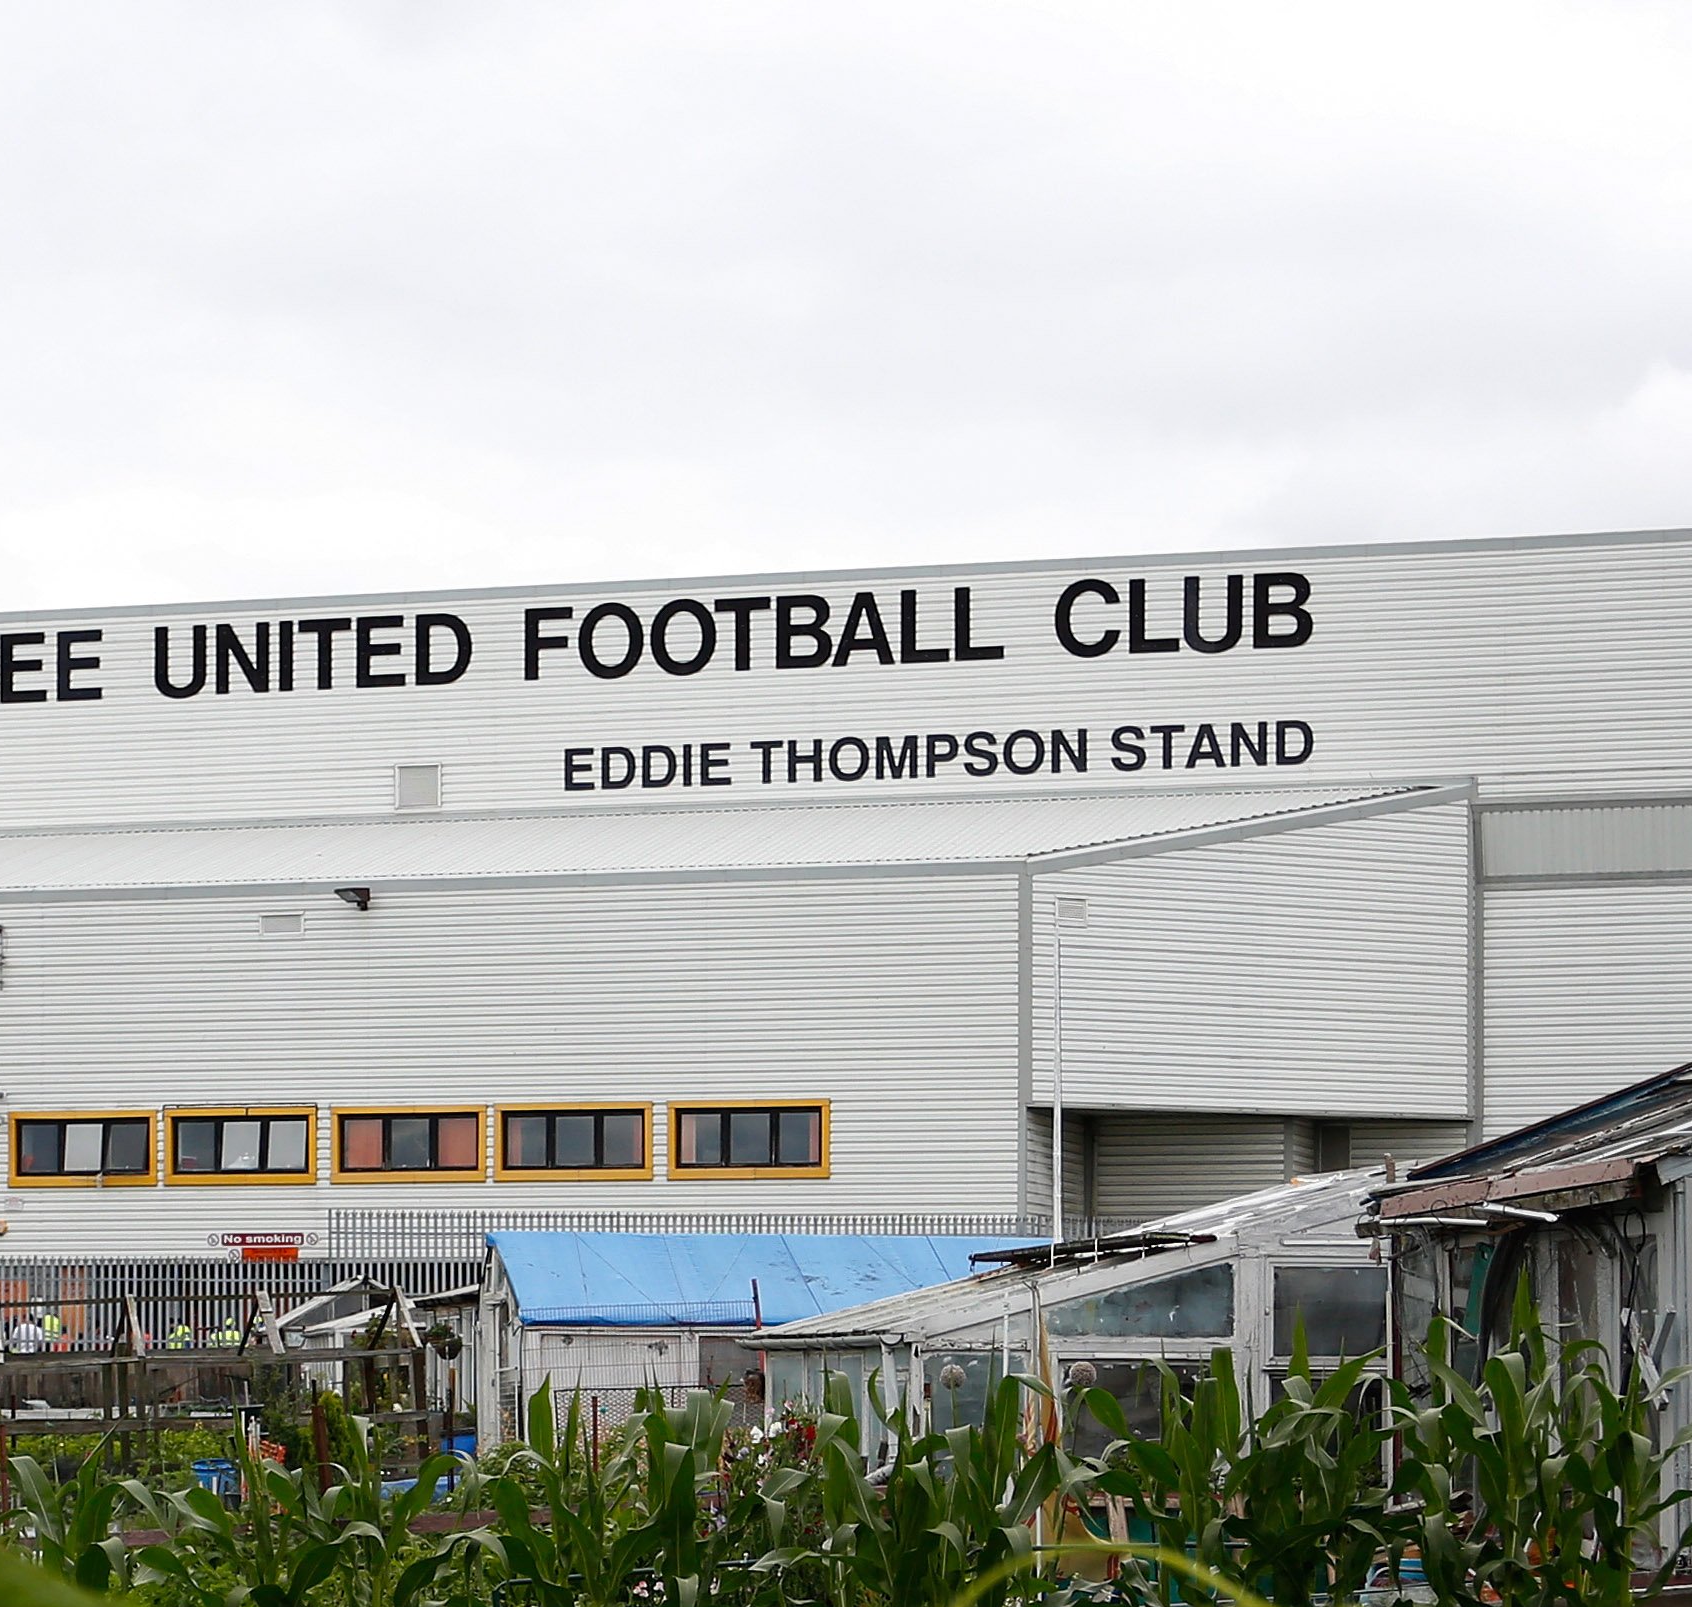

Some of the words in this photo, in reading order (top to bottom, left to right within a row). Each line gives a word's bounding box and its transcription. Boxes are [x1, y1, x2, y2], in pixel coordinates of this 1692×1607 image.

[153, 613, 474, 699] UNITED
[523, 586, 1006, 681] FOOTBALL
[1053, 571, 1315, 660] CLUB
[563, 742, 733, 792] EDDIE
[748, 728, 1089, 785] THOMPSON
[1109, 719, 1316, 772] STAND
[223, 1234, 242, 1244] No
[245, 1234, 302, 1244] smoking
